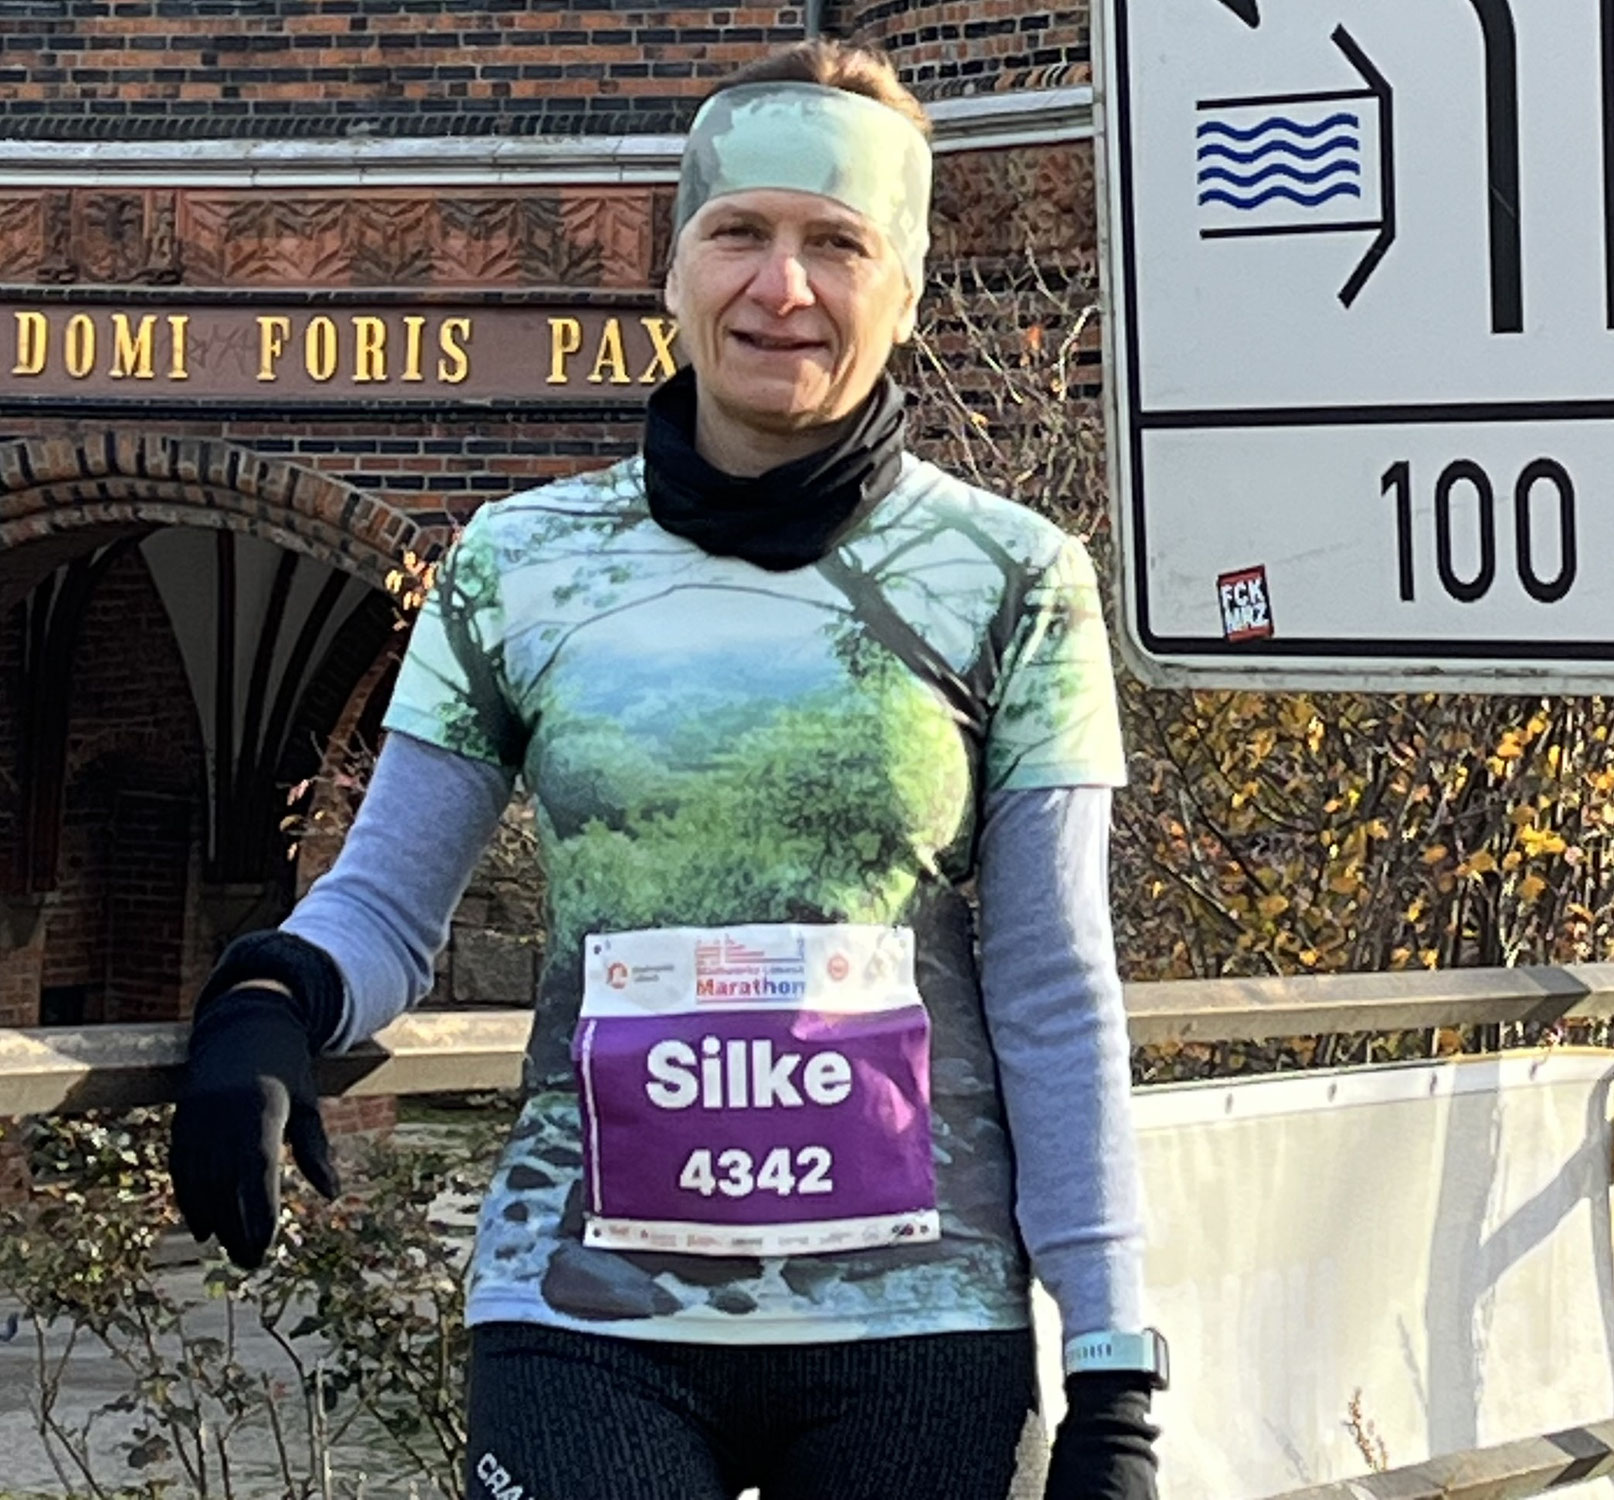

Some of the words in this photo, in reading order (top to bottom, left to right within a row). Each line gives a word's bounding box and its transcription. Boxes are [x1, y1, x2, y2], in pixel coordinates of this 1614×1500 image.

[11, 311, 190, 379] DOMI
[255, 315, 472, 383] FORIS
[545, 317, 681, 384] PAX
[1380, 457, 1577, 604] 100
[1221, 579, 1264, 609] FCK
[696, 976, 805, 997] Marathon
[645, 1035, 852, 1110] Silke
[679, 1146, 833, 1197] 4342
[477, 1452, 535, 1500] CRA
